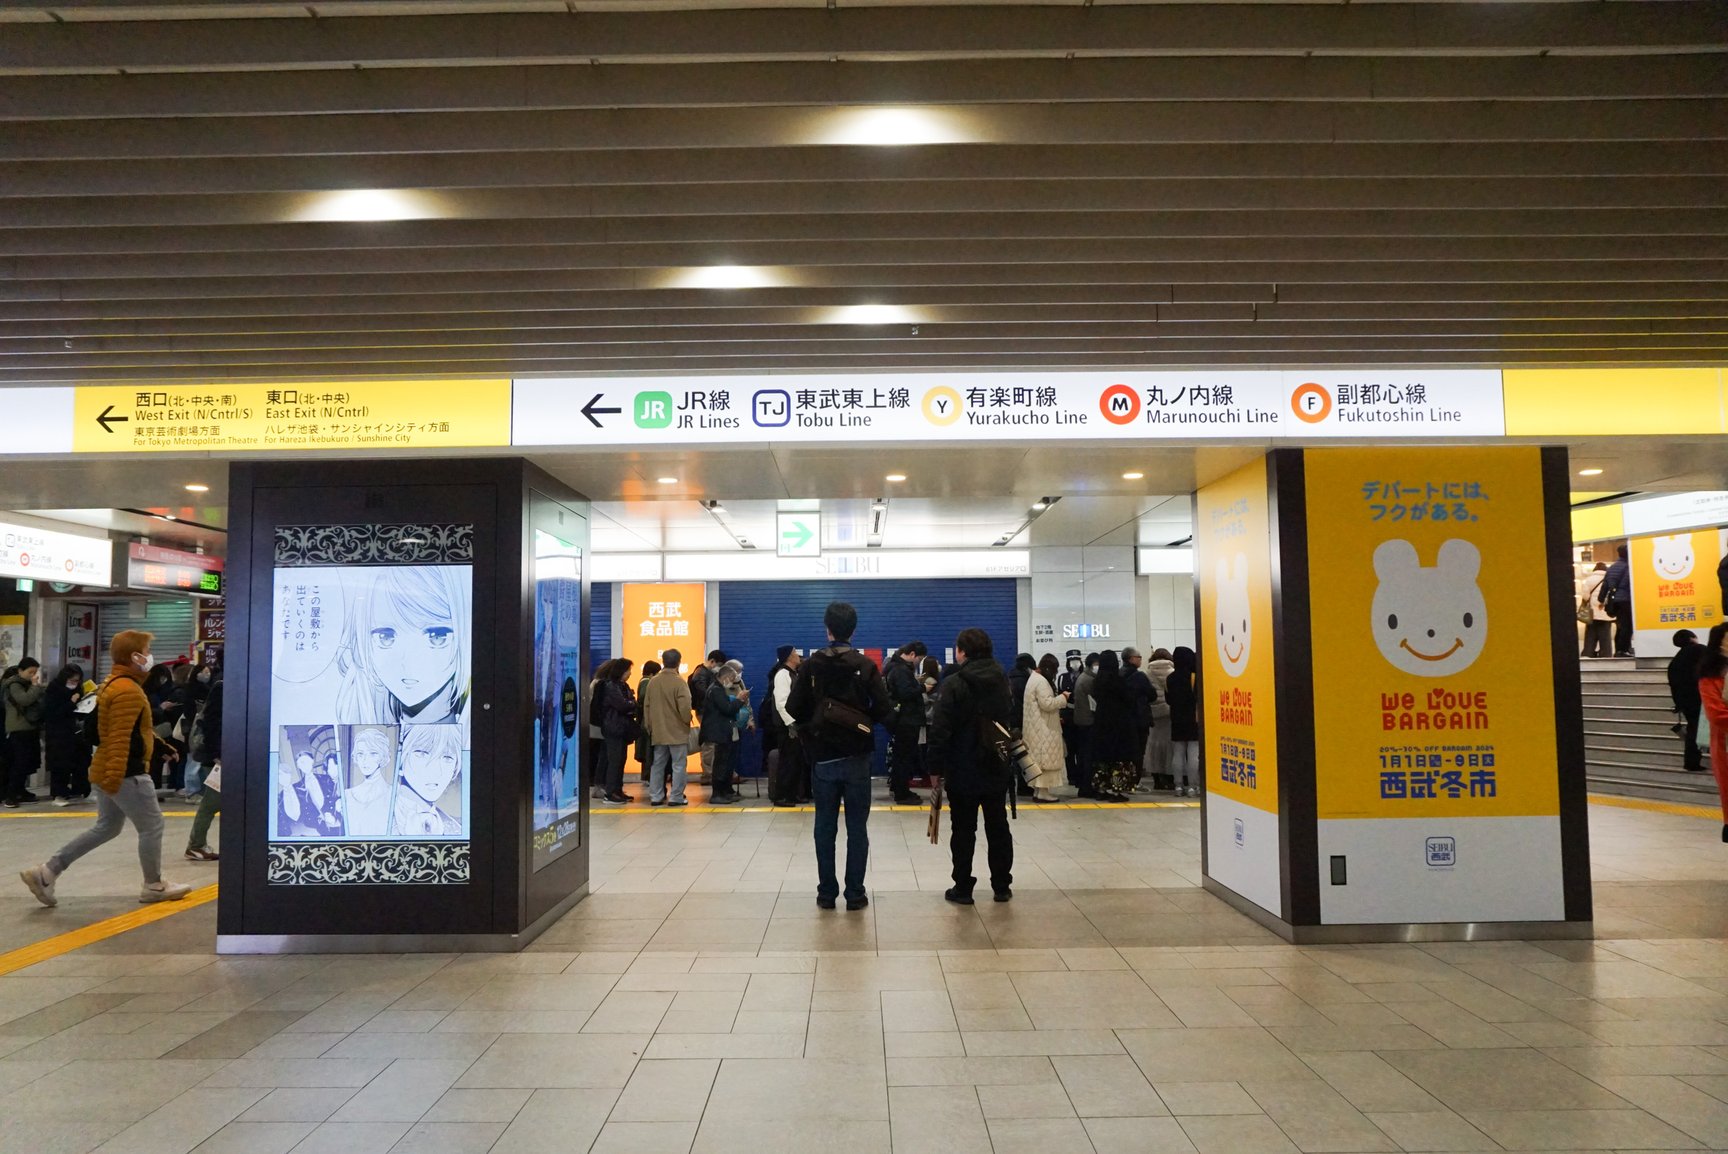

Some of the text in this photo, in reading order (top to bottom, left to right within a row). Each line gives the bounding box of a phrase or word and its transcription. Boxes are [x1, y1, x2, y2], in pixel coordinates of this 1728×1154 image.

[677, 391, 730, 410] JR線
[796, 388, 910, 410] 東武東上線
[967, 386, 1057, 408] 有楽町線
[1147, 385, 1233, 407] 丸ノ内線
[1337, 384, 1426, 405] 副都心線
[640, 400, 665, 420] JR
[759, 401, 785, 416] TJ
[937, 400, 948, 413] Y
[1112, 398, 1128, 411] M
[1307, 397, 1316, 410] F
[135, 407, 253, 421] West Exit (N/Cntrl/S)
[266, 406, 369, 420] East Exit (N/Cntrl)
[677, 411, 739, 428] JR Lines
[796, 411, 872, 427] Tobu Line
[967, 410, 1088, 426] Yurakucho Line
[1147, 408, 1279, 424] Marunouchi Line
[1338, 406, 1461, 423] Fukutoshin Line
[134, 426, 220, 437] 東京芸術劇場方面
[265, 435, 276, 444] For
[278, 435, 306, 444] Hareza
[310, 434, 350, 443] Ikebukuro
[357, 434, 393, 443] Sunshine
[395, 434, 411, 444] City
[149, 438, 171, 447] Tokyo
[173, 437, 226, 447] Metropolitan
[228, 436, 258, 445] Theatre
[1361, 481, 1489, 501] デパートには、
[1368, 503, 1479, 522] フクがある。
[281, 584, 292, 640] あなたです
[295, 585, 307, 651] 出ていくのは
[310, 585, 321, 651] この屋敷から
[648, 601, 682, 618] 西武
[640, 620, 689, 636] 食品館
[1063, 623, 1110, 638] SEIBU
[1220, 708, 1253, 727] BARGAIN
[1382, 711, 1488, 730] BARGAIN
[1380, 770, 1496, 799] 西武冬市
